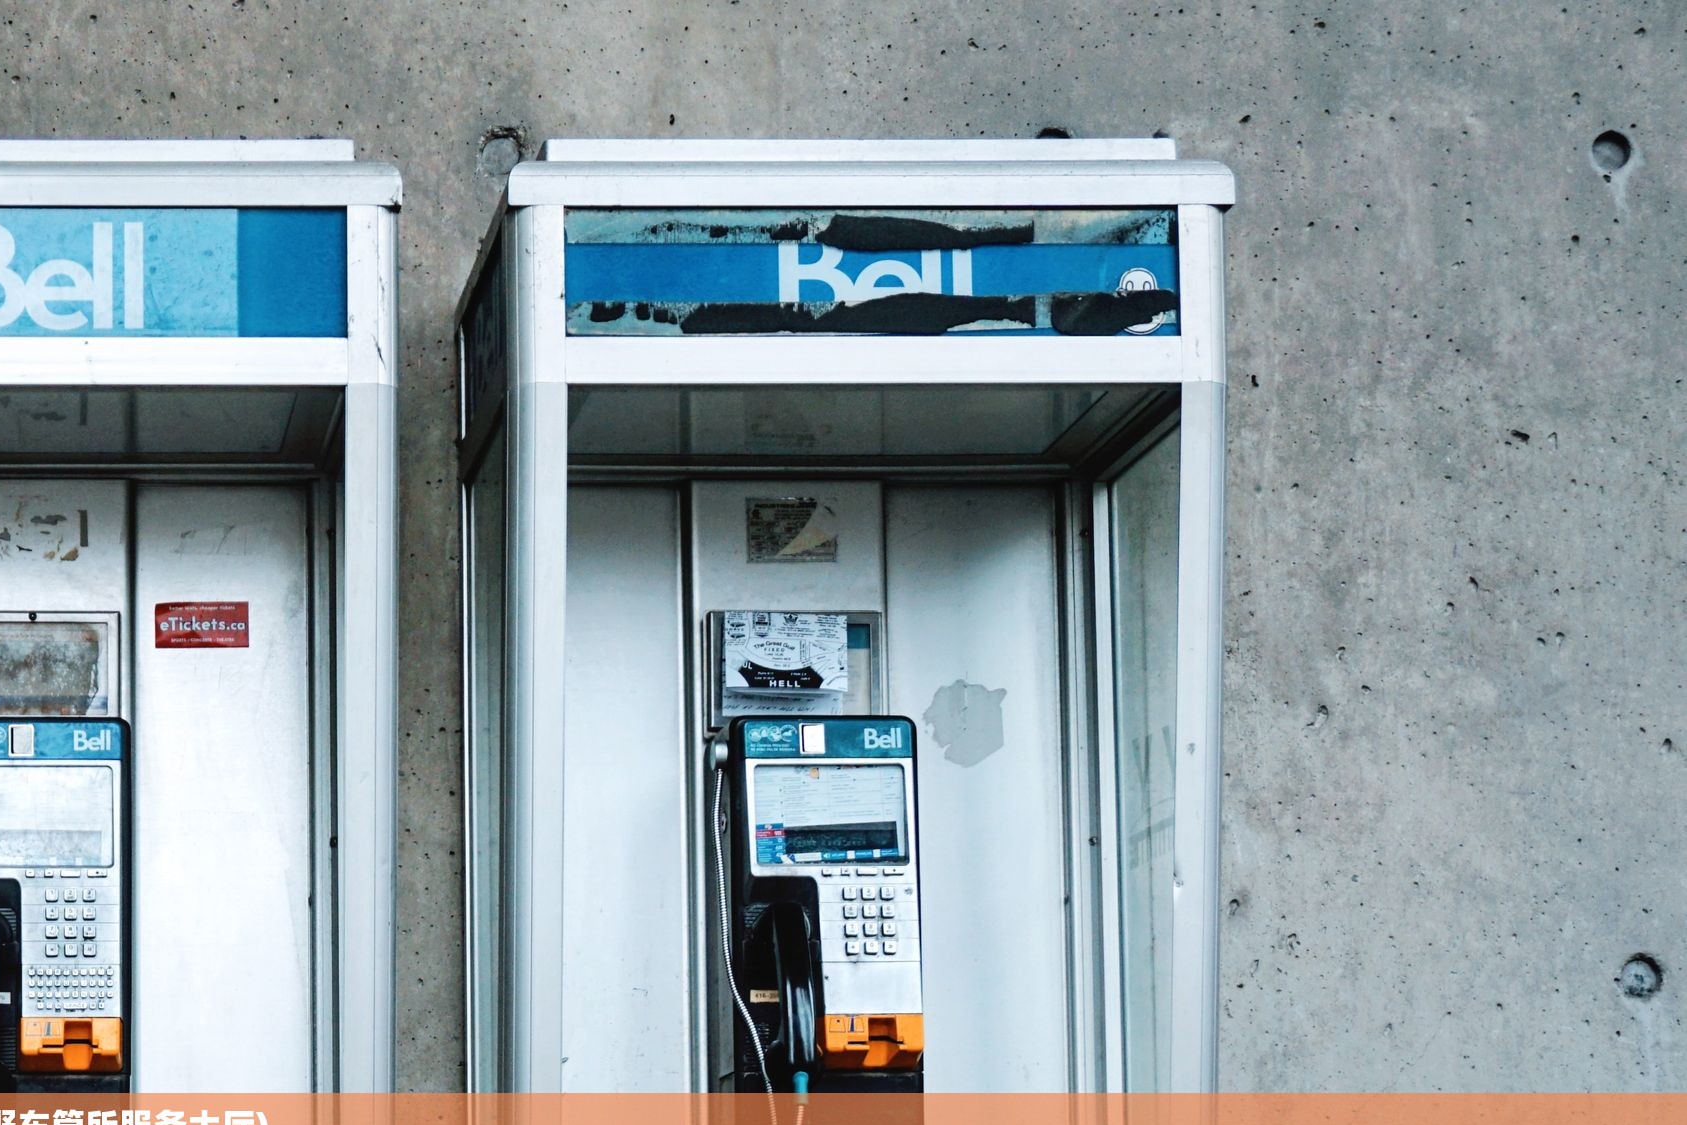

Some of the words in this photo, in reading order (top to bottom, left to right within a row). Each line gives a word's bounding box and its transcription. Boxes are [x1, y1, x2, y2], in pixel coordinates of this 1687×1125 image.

[160, 616, 245, 631] eTickets.ca
[769, 680, 801, 688] HELL
[73, 729, 111, 751] Bell
[864, 728, 902, 749] Bell
